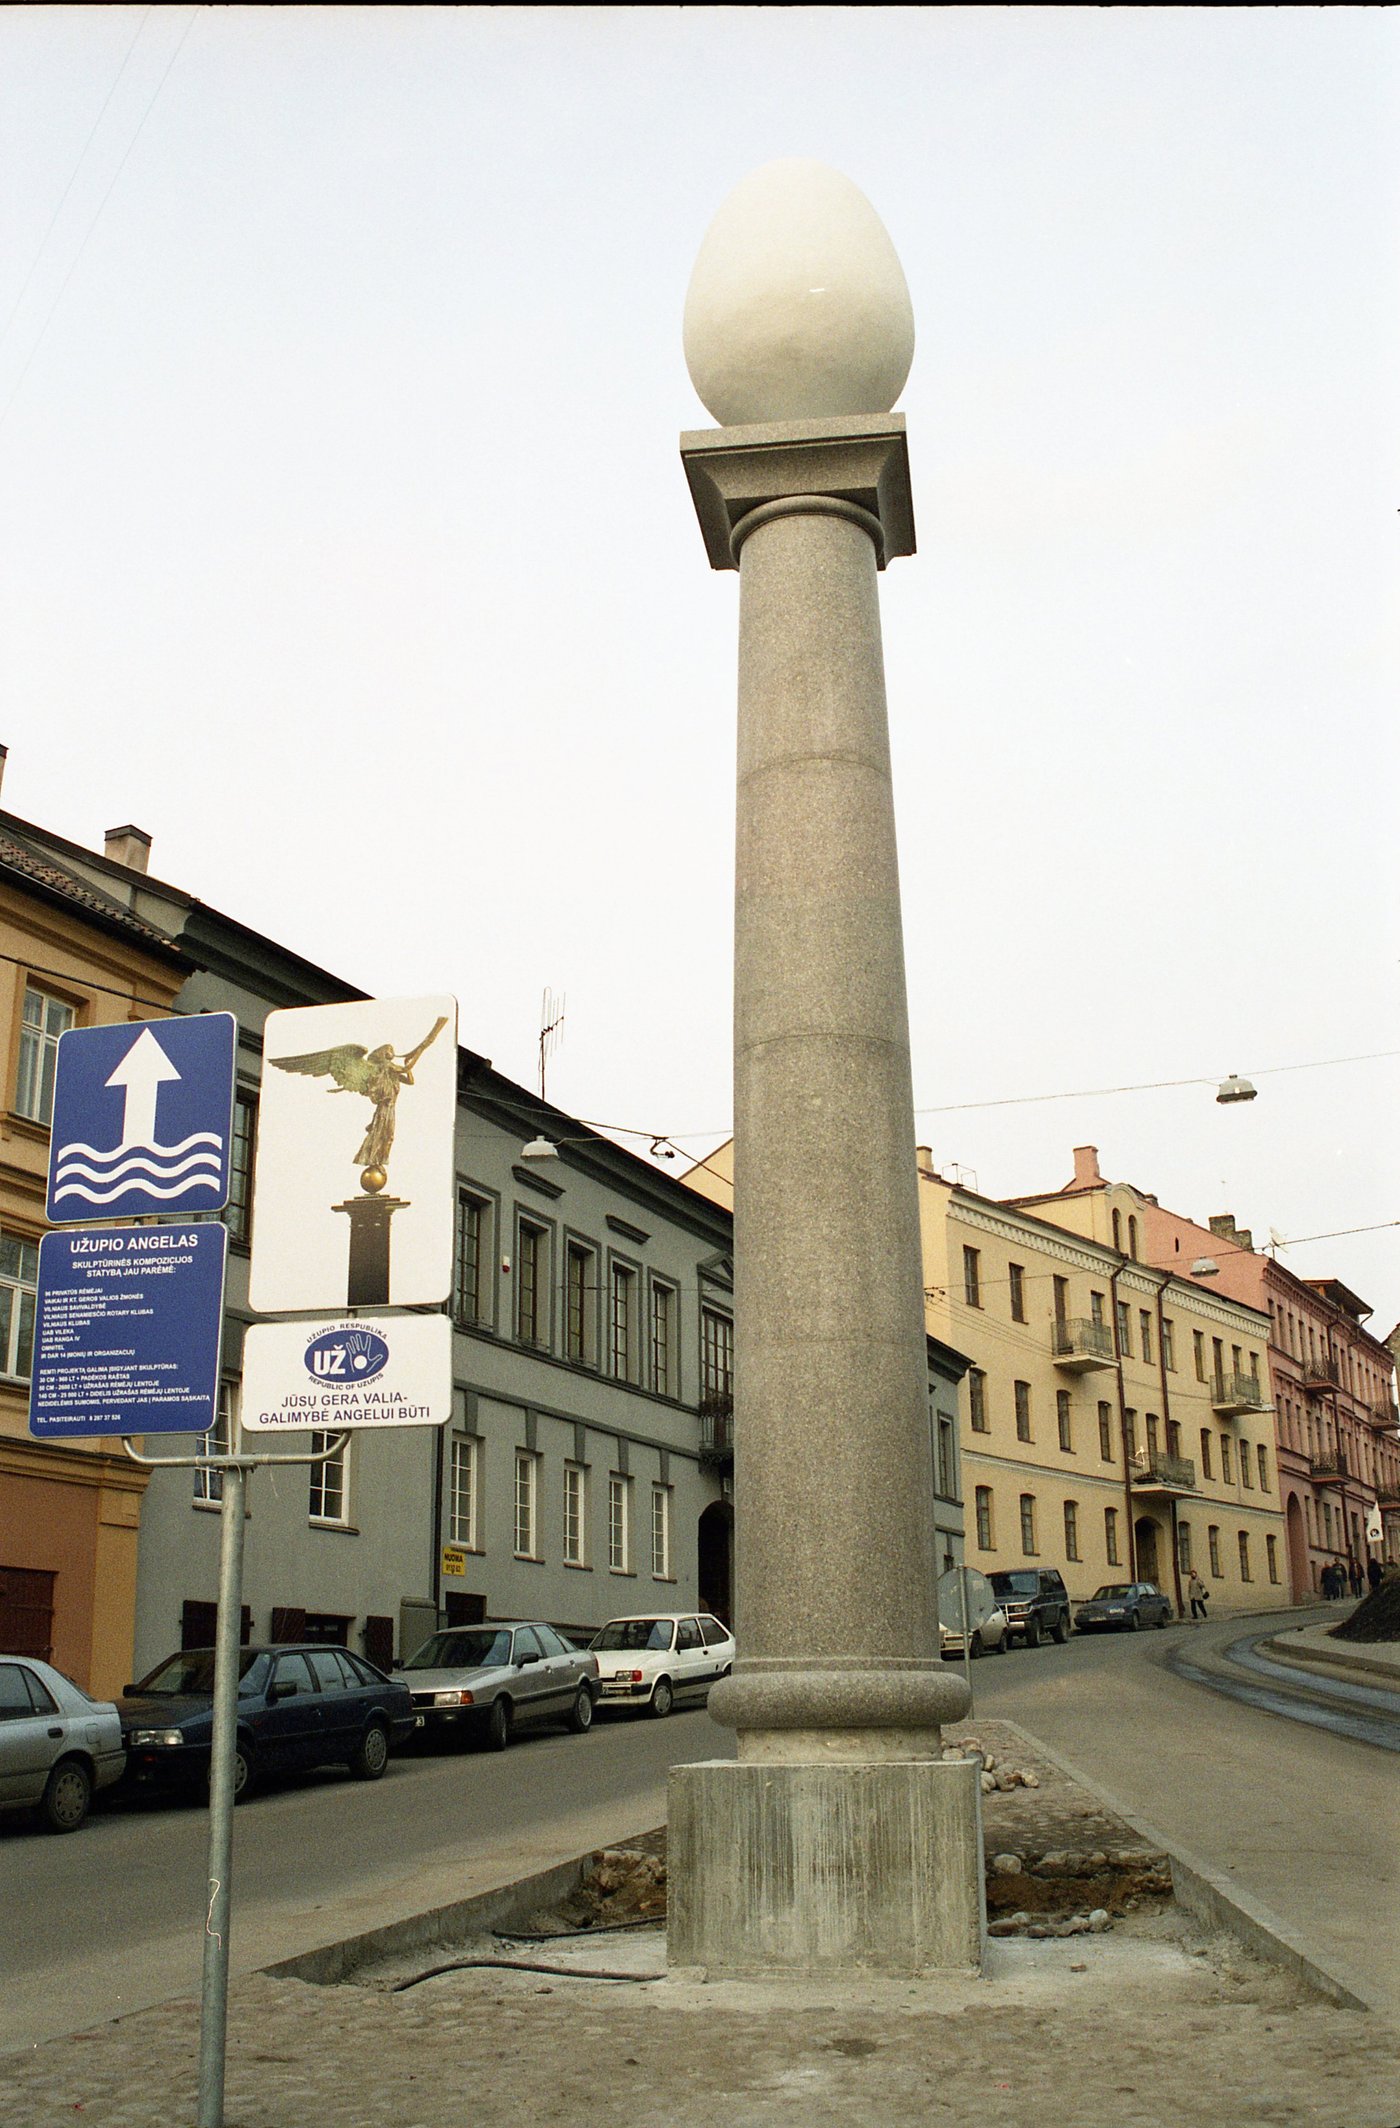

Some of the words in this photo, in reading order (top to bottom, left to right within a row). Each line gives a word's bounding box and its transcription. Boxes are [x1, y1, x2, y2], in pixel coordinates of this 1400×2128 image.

[70, 1237, 123, 1253] UŽUPIO
[127, 1234, 198, 1250] ANGELAS
[72, 1258, 131, 1269] SKULPTŪRINĖS
[133, 1256, 193, 1266] KOMPOZICIJOS
[86, 1269, 122, 1277] STATYBĄ
[123, 1268, 139, 1276] JAU
[340, 1323, 388, 1340] RESPUBLIKA
[313, 1344, 346, 1376] UŽ
[308, 1375, 343, 1390] REPUBLIC
[281, 1394, 316, 1410] JŪSŲ
[321, 1393, 359, 1407] GERA
[364, 1392, 408, 1405] VALIA-
[259, 1408, 328, 1424] GALIMYBĖ
[333, 1408, 394, 1421] ANGELUI
[398, 1405, 430, 1419] BŪTI
